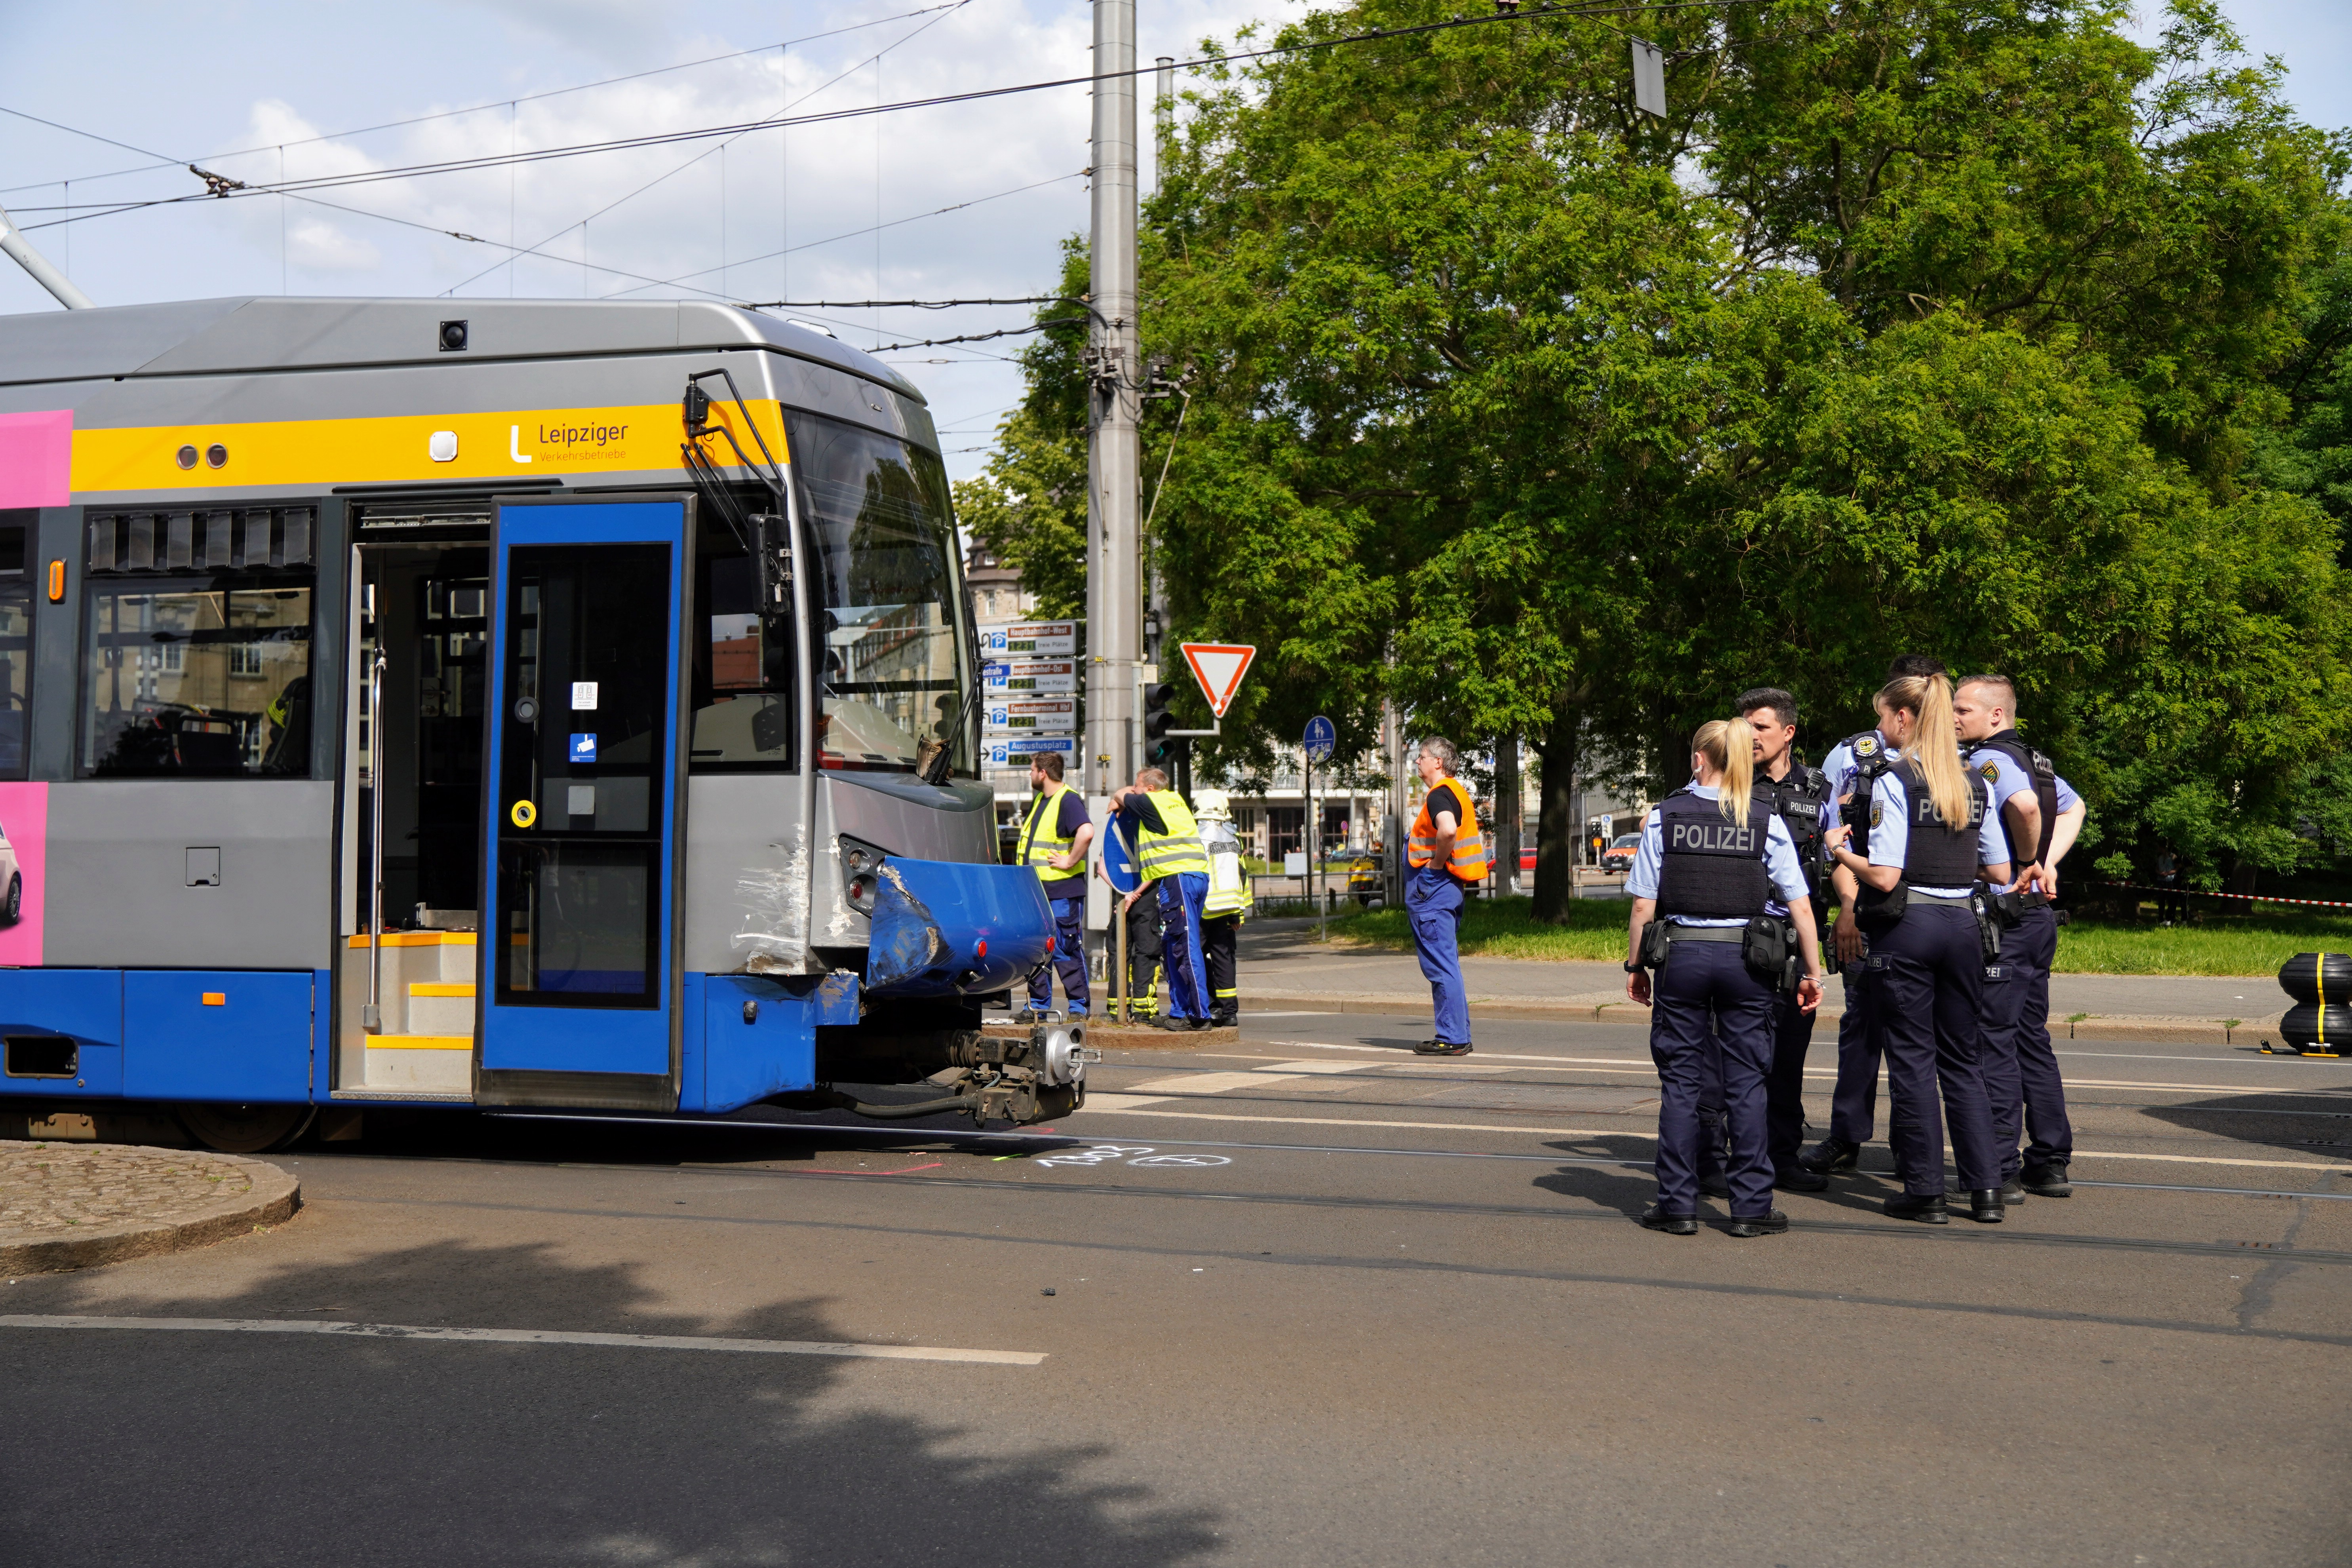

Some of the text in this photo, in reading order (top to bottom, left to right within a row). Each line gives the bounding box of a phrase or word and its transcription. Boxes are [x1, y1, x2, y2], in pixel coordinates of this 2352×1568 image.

[540, 422, 628, 447] Leipziger
[540, 448, 626, 462] Verkehrsbetriebe
[1010, 627, 1067, 637] Hauptbahnhof-West
[1013, 665, 1063, 675] auptbahnhof-Ost
[1010, 704, 1058, 712] Fernbusterminal
[1012, 742, 1067, 751] Augustusplatz
[1980, 762, 1992, 774] OLIZEI
[1791, 801, 1816, 814] POLIZEI
[1918, 799, 1984, 823] POEI
[1673, 824, 1755, 852] POLIZEI
[1867, 957, 1882, 967] OLIZEI
